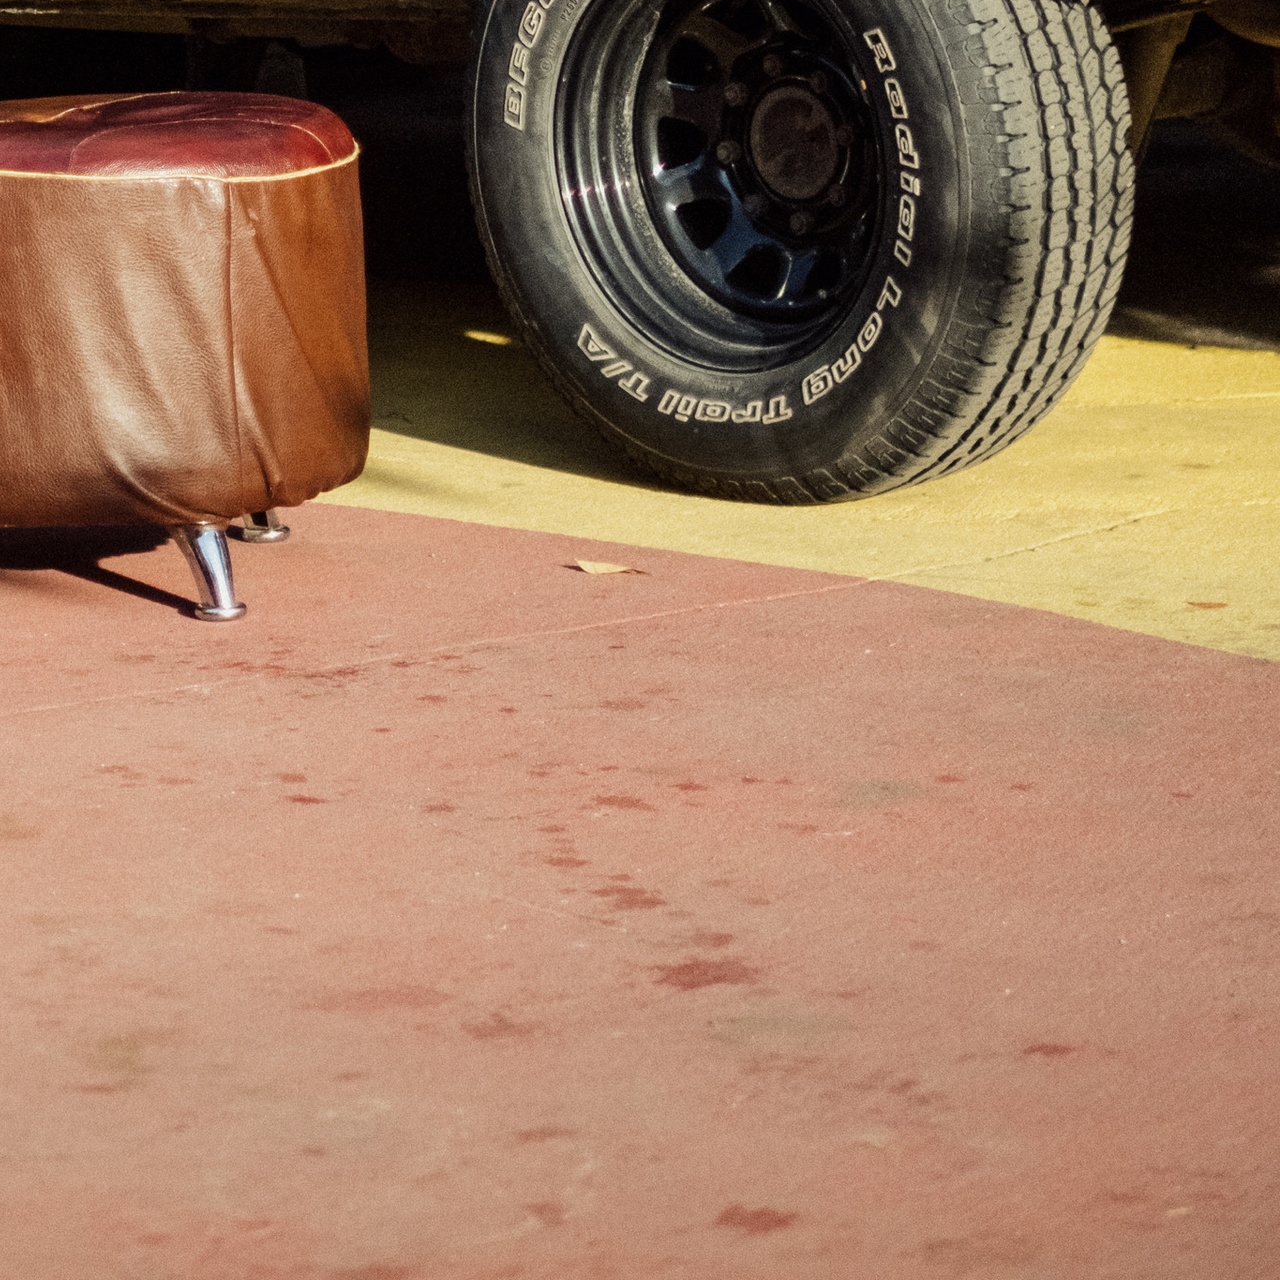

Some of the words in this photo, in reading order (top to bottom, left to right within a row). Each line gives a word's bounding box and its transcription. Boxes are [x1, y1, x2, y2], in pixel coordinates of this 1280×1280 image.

[863, 28, 921, 268] Radial
[577, 322, 651, 403] T/A
[801, 276, 904, 406] Long
[656, 389, 793, 425] Trail
